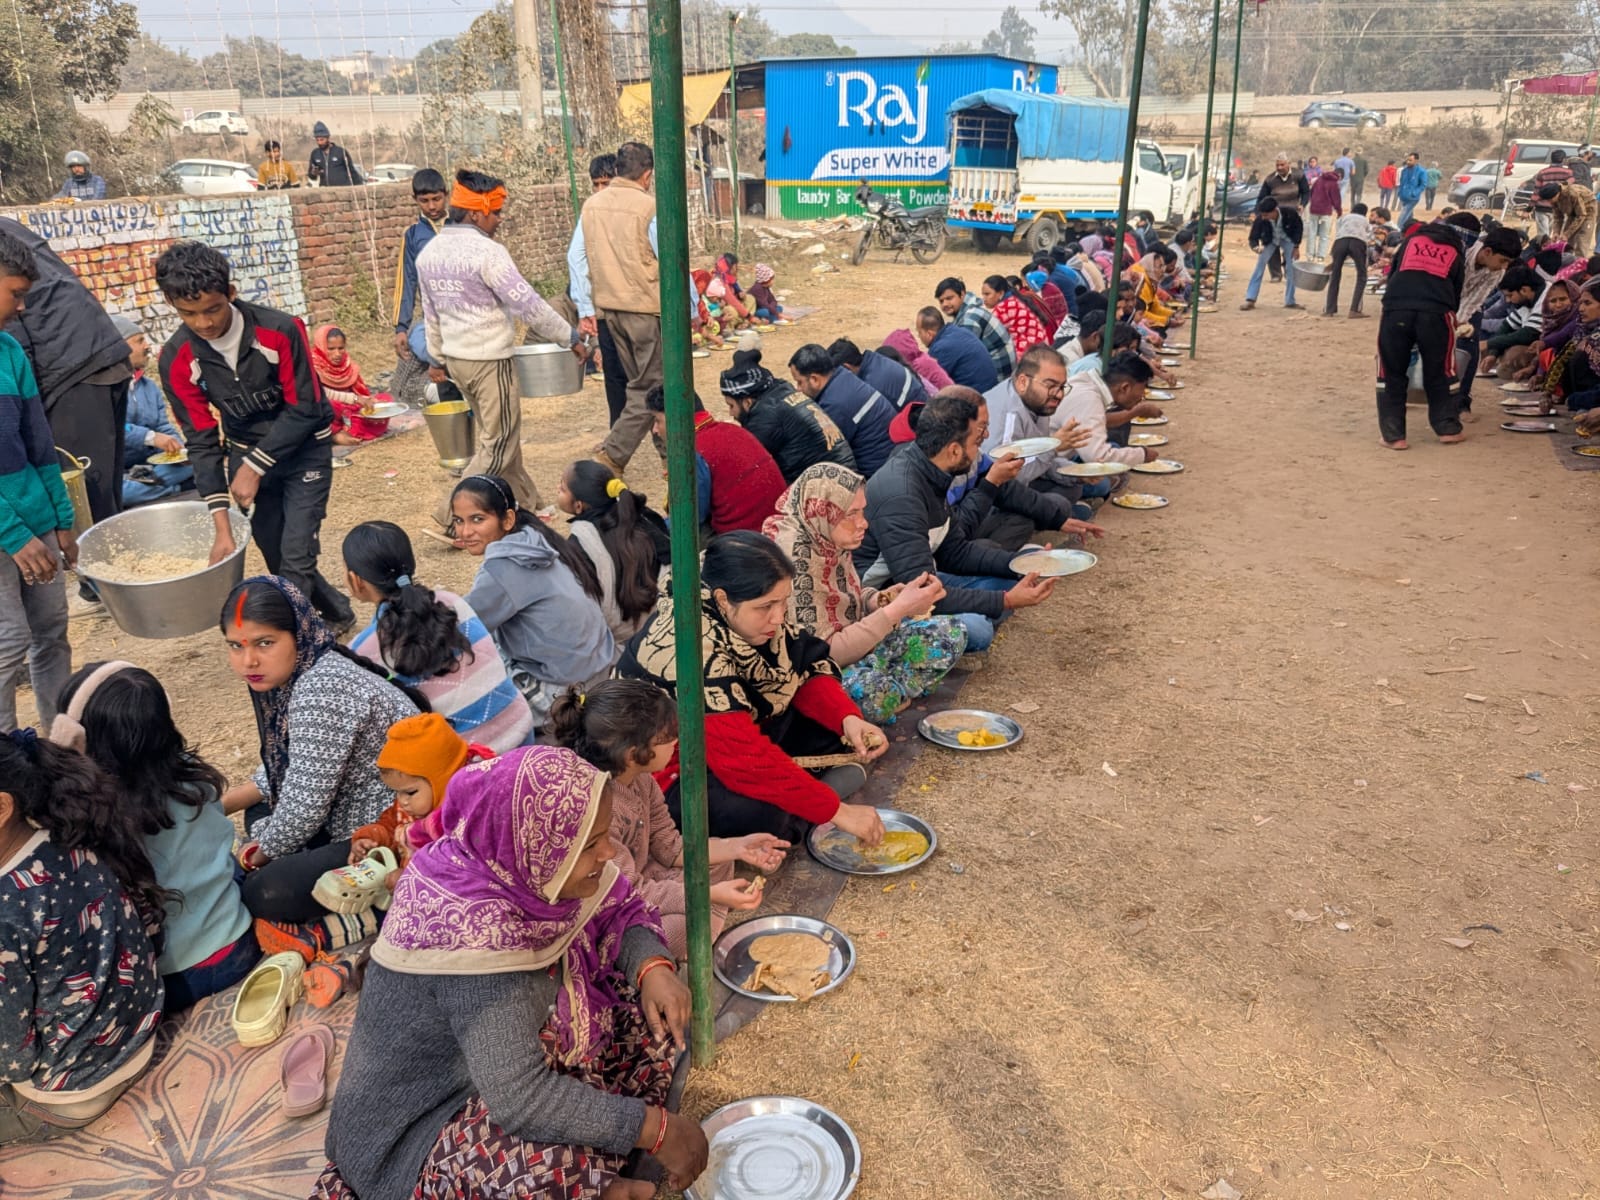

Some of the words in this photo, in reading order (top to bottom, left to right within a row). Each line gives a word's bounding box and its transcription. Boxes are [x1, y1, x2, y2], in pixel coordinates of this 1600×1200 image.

[837, 70, 928, 145] Raj
[831, 154, 880, 174] Super
[885, 151, 938, 169] White
[836, 188, 851, 204] Bar
[429, 279, 464, 292] BOSS
